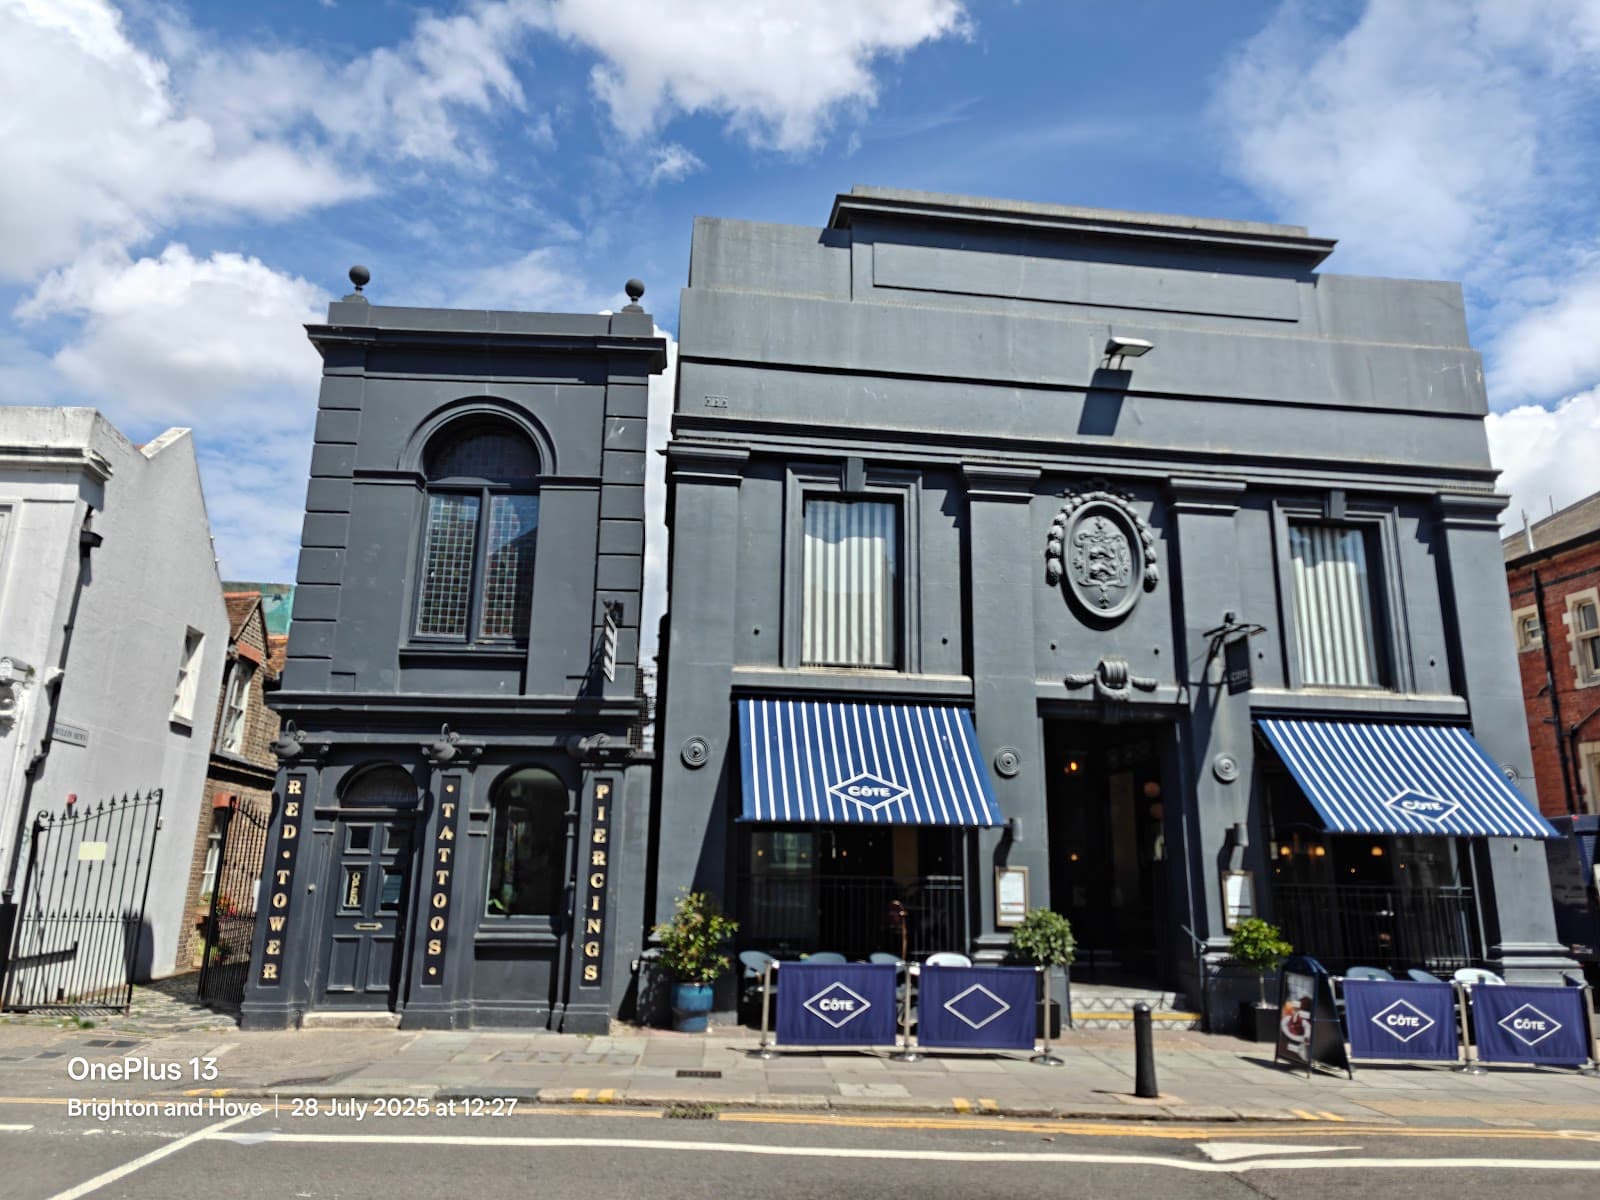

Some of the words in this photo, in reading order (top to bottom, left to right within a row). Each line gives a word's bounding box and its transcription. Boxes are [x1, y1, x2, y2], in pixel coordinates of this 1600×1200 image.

[281, 779, 302, 839] RED
[847, 785, 891, 798] CÔTE
[427, 802, 456, 956] TATTOOS
[583, 784, 610, 982] PIERCINGS
[263, 870, 291, 979] TOWER
[819, 997, 855, 1011] CÔTE
[1386, 1013, 1420, 1027] CÔTE
[1513, 1018, 1546, 1031] CÔTE
